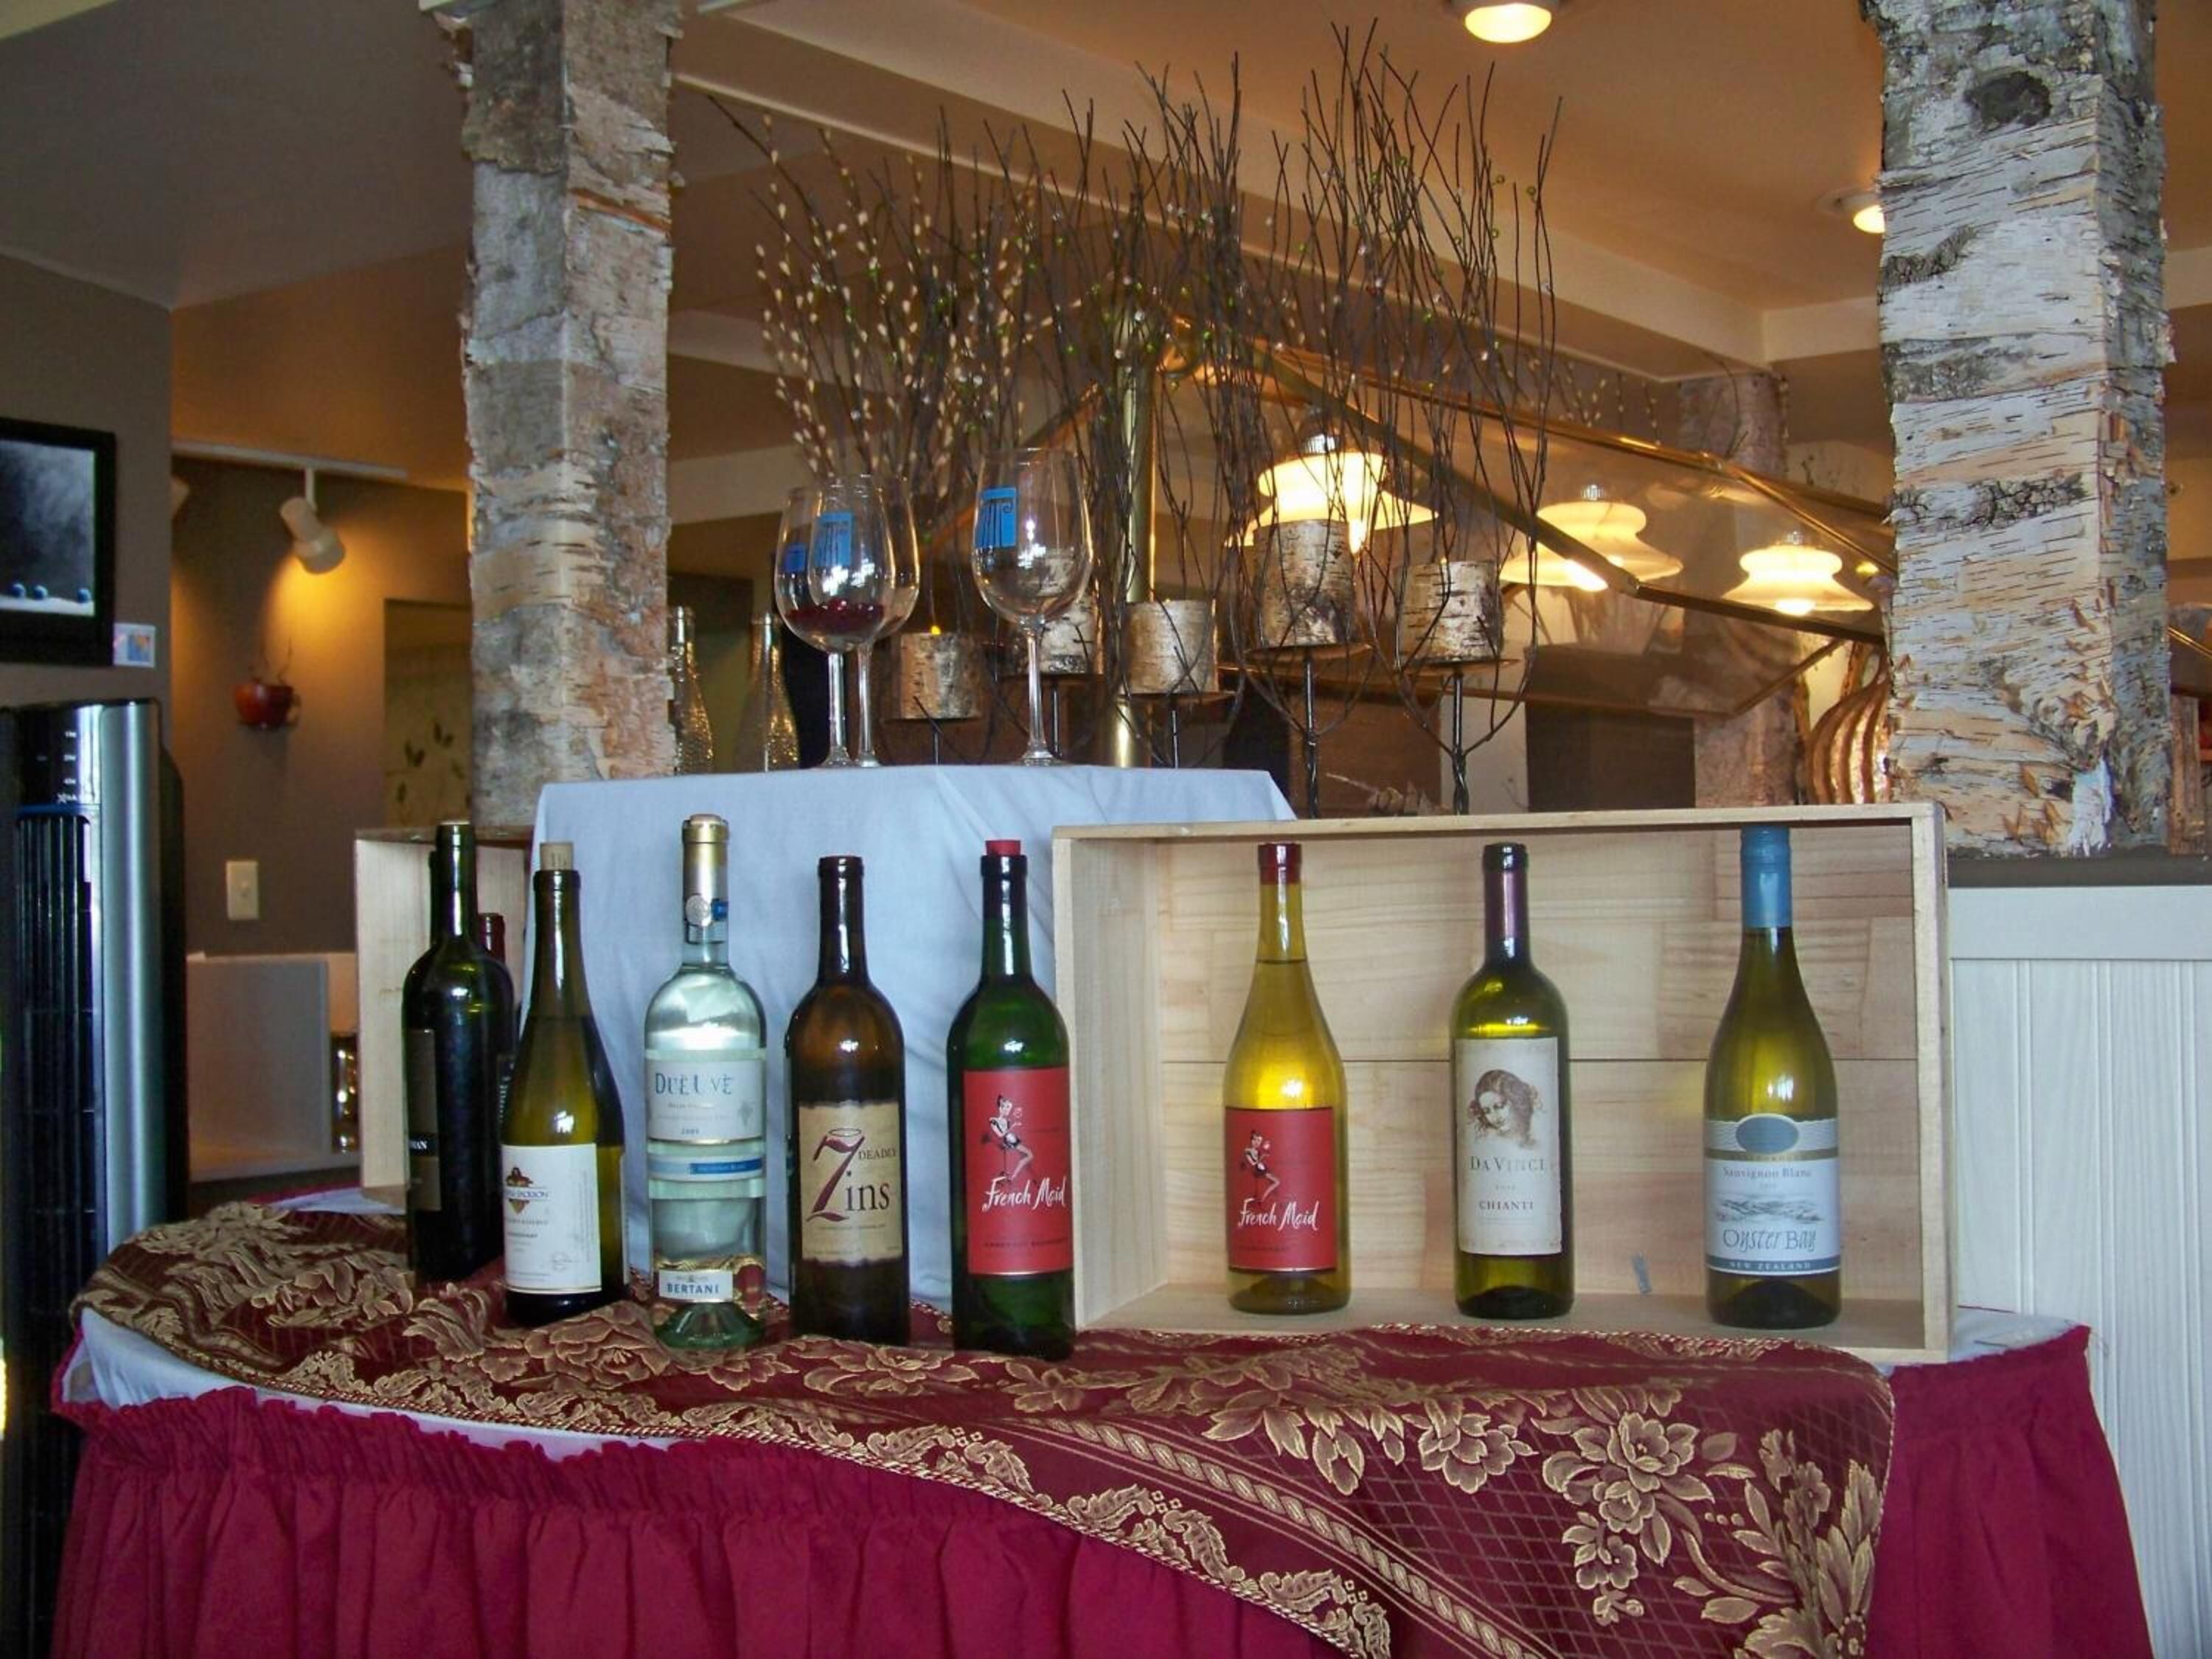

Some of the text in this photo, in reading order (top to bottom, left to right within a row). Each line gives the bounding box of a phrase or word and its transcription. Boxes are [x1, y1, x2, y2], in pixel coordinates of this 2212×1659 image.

[858, 1147, 897, 1160] DEADLY
[1722, 1166, 1779, 1179] Sauvignon
[981, 1175, 1067, 1212] French Maid
[1478, 1201, 1534, 1210] CHIANTI
[1238, 1198, 1320, 1231] French Maid
[1729, 1262, 1811, 1270] NEW ZEALAND
[667, 1283, 719, 1294] BERTANI
